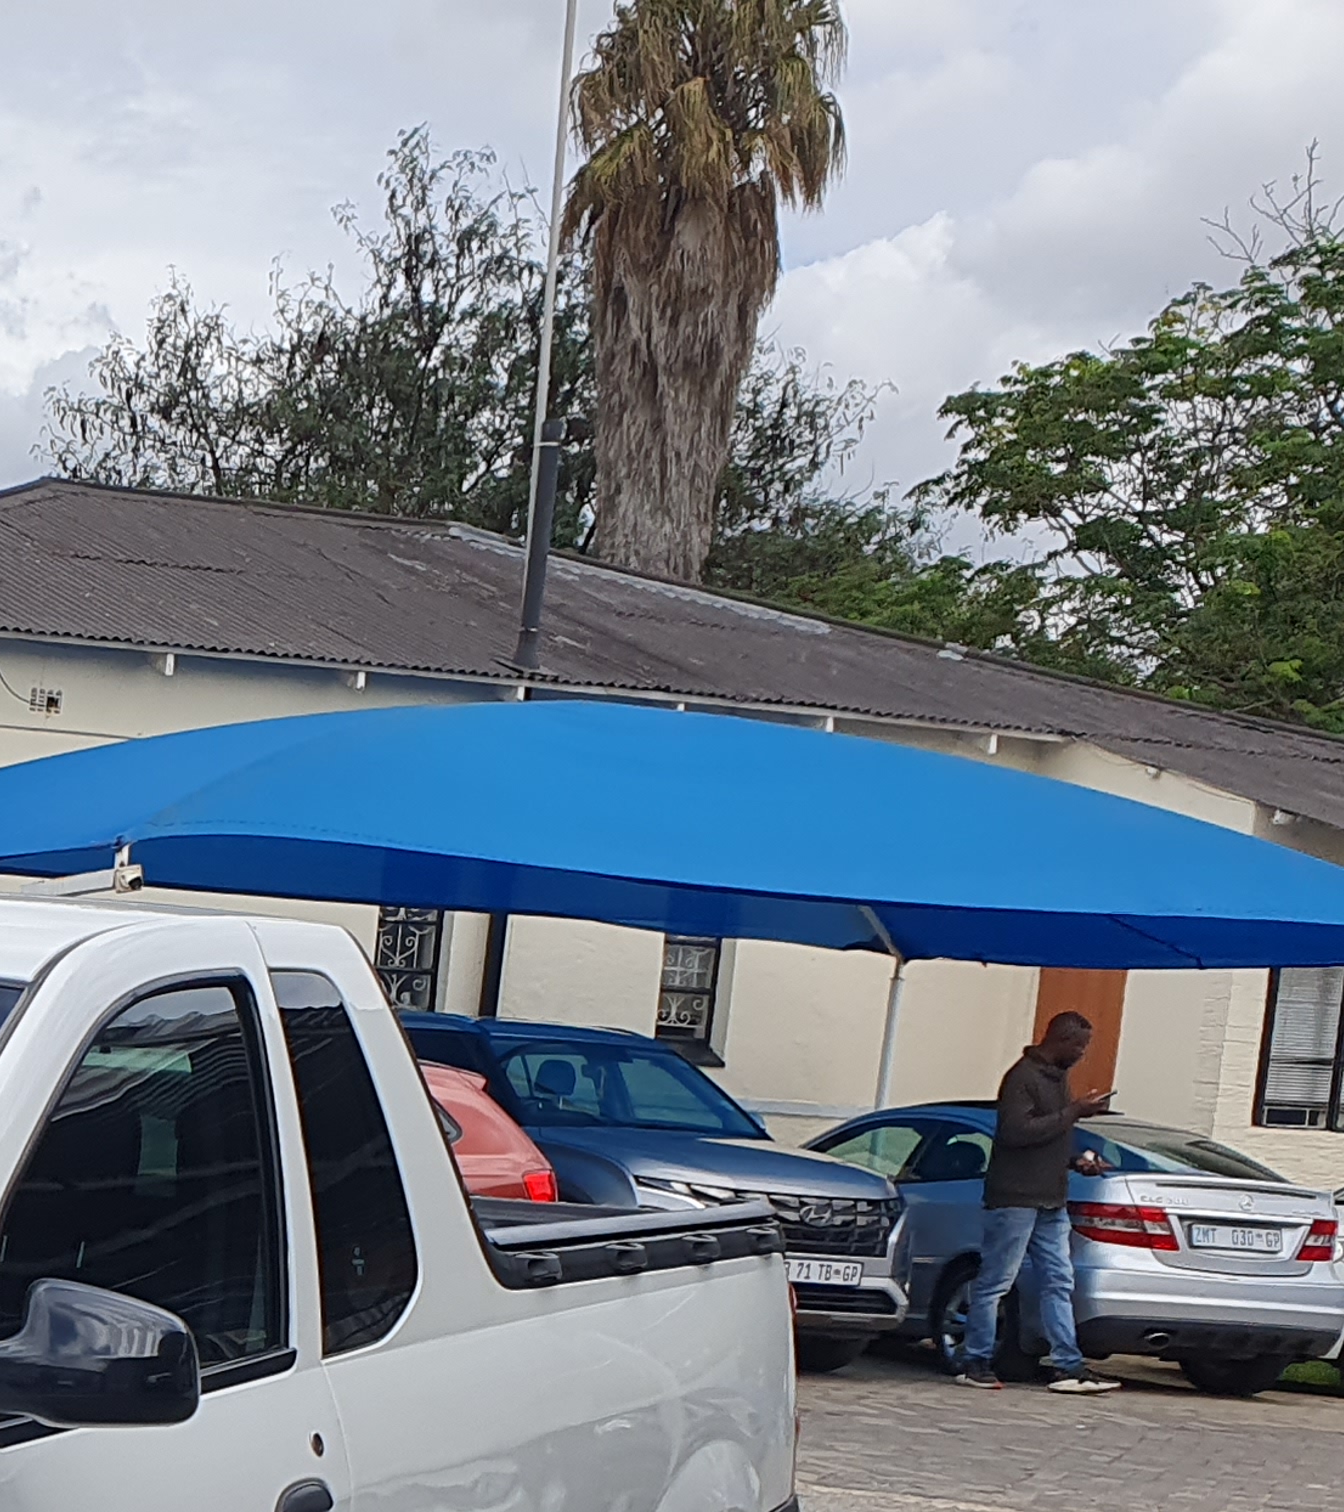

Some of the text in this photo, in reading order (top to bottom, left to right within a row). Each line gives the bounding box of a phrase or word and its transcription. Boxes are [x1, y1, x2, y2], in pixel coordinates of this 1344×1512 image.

[1265, 1232, 1280, 1248] GP
[796, 1262, 811, 1280] 71
[818, 1263, 833, 1281] TB
[842, 1265, 858, 1282] GP
